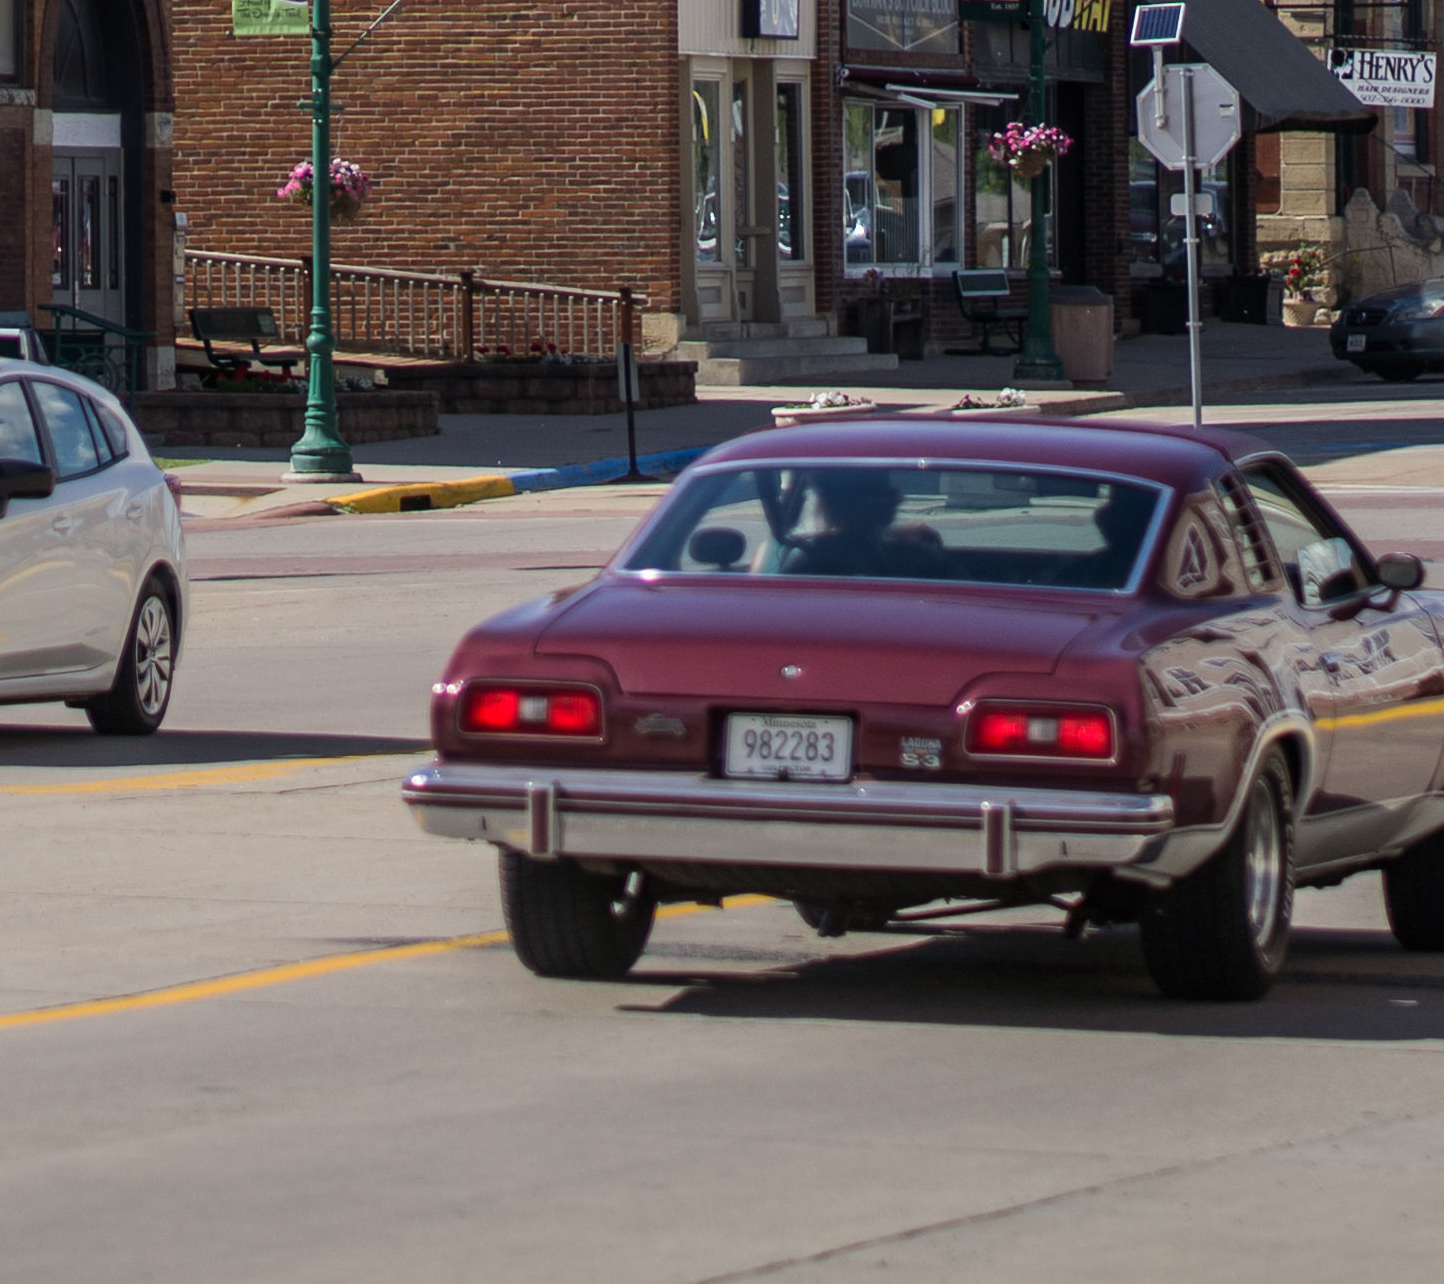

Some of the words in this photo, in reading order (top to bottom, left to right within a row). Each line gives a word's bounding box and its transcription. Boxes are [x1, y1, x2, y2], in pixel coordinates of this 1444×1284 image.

[1357, 50, 1433, 83] HENRY'S
[1381, 86, 1430, 95] DESIGNERS
[762, 716, 817, 729] Minnesota
[744, 729, 834, 762] 982283
[902, 736, 942, 749] LAGUNA
